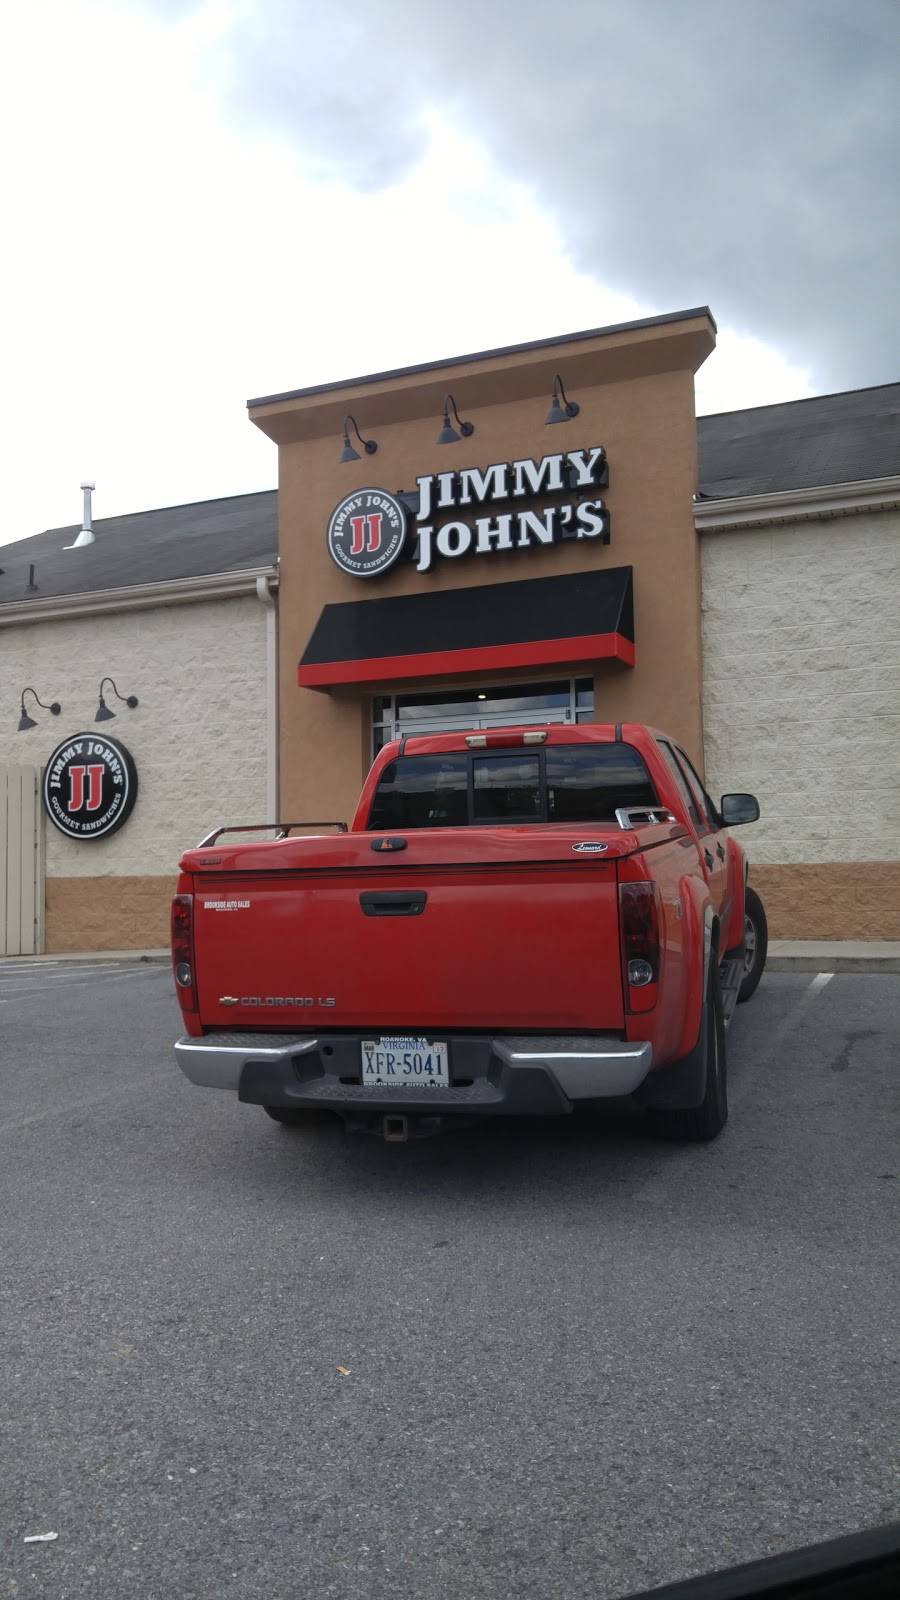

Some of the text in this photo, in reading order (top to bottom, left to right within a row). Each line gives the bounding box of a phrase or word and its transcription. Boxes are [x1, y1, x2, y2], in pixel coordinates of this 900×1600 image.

[416, 447, 602, 521] JIMMY
[334, 495, 399, 537] JIMMY JOHN'S
[350, 512, 382, 555] JJ
[416, 500, 604, 571] JOHN'S
[335, 534, 398, 569] GOURMET SANDWICHES
[50, 742, 122, 788] JIMMY JOHN'S
[68, 764, 105, 812] JJ
[52, 793, 121, 831] GOURMET SANDWICHES
[237, 900, 250, 908] SALES
[240, 997, 336, 1007] COLORADO LS
[365, 1052, 443, 1076] XFR-5041
[383, 1041, 426, 1050] VIRGINIA
